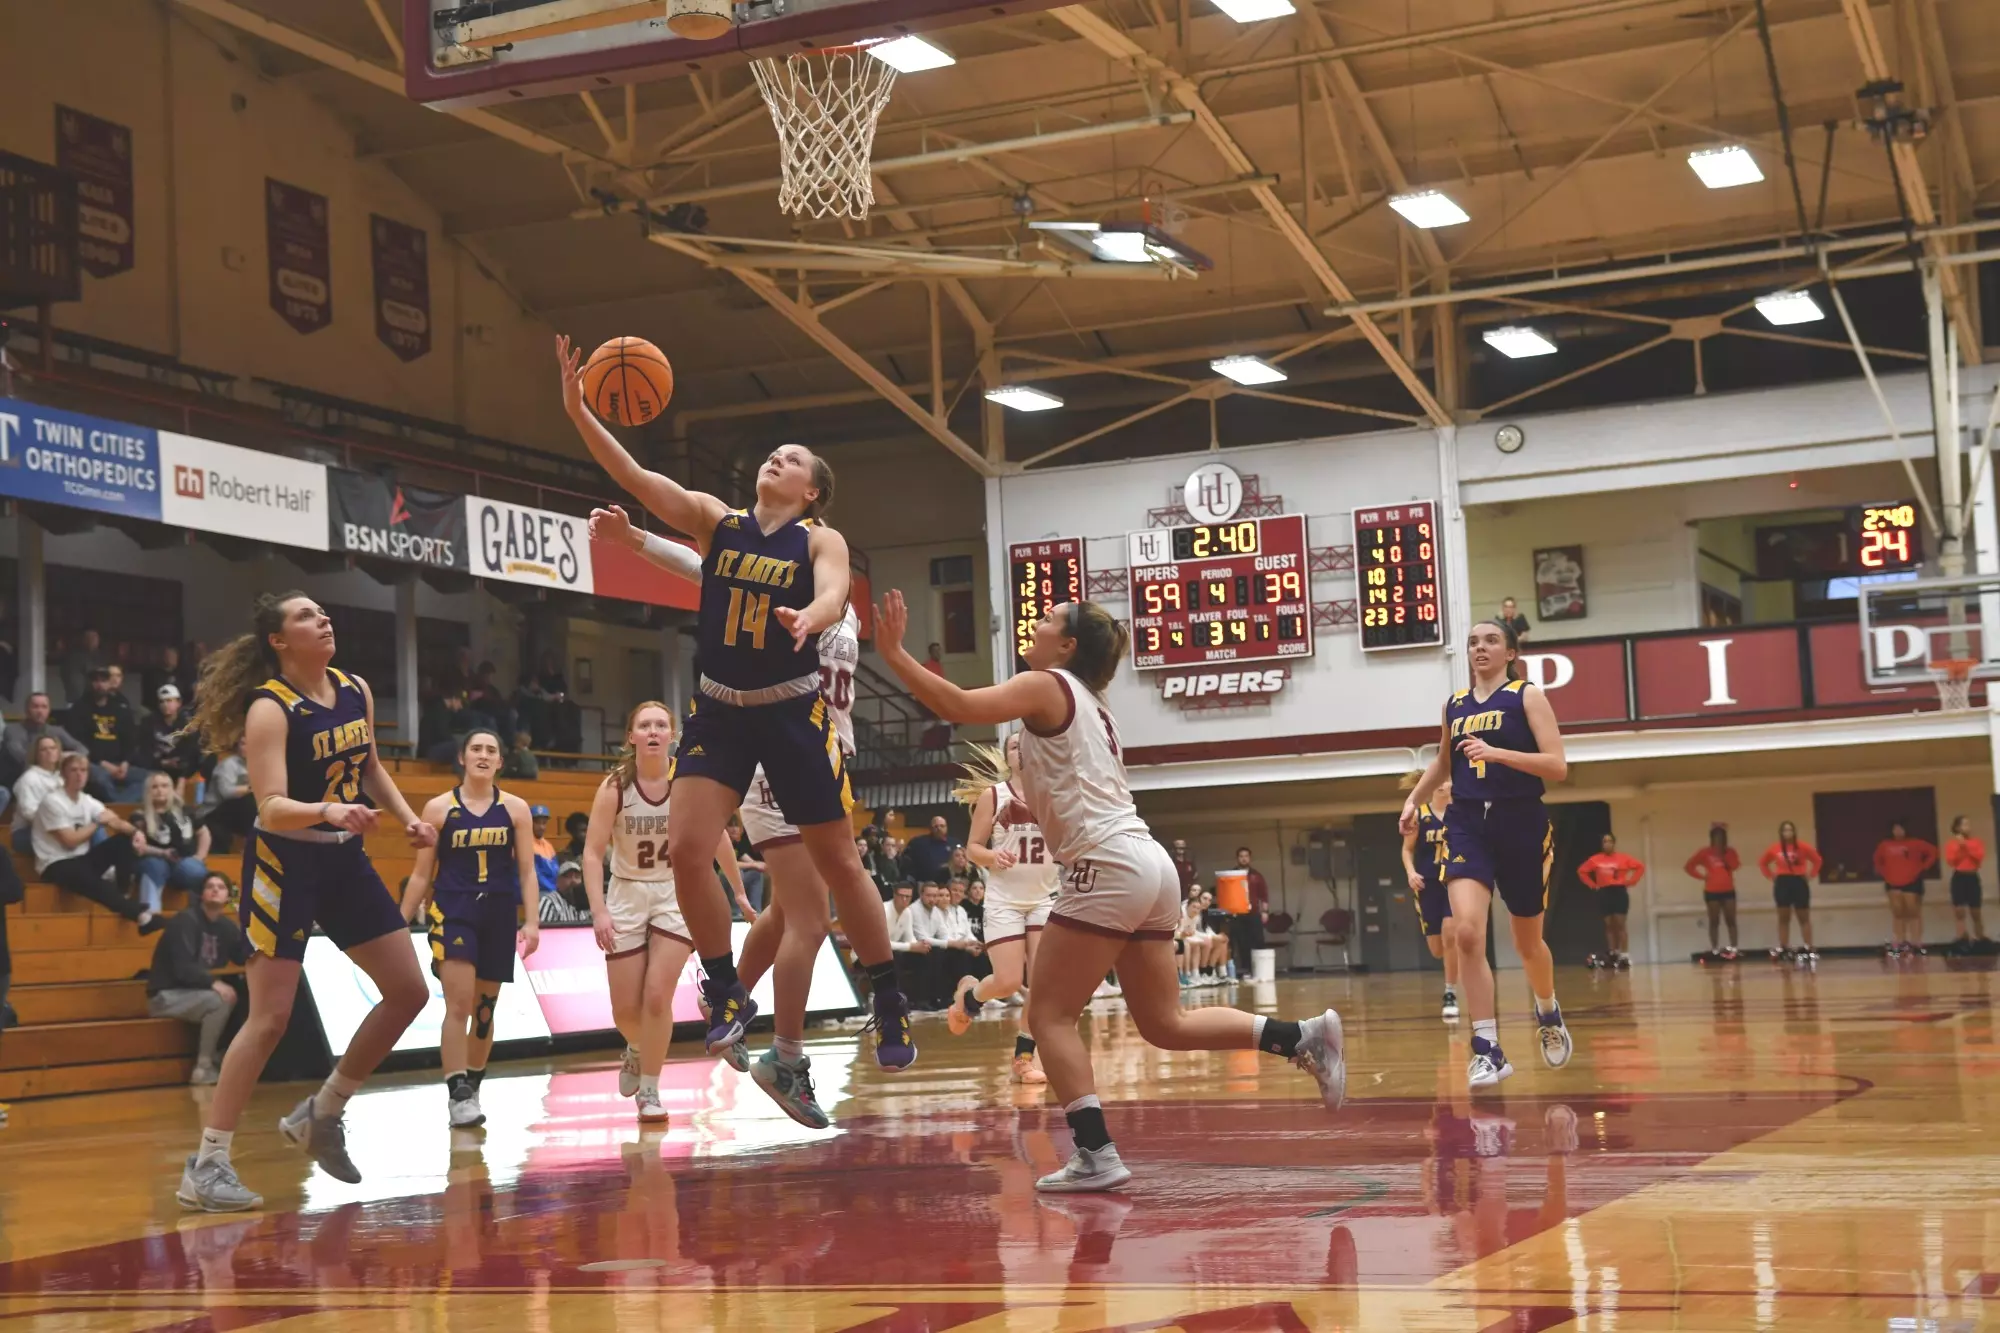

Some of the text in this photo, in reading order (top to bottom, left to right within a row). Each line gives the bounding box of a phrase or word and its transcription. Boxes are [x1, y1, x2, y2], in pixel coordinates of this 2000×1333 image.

[33, 418, 146, 461] TWIN CITIES
[26, 447, 156, 492] ORTHOPEDICS
[208, 470, 311, 513] Robert Half
[1196, 472, 1233, 516] HU
[1360, 507, 1424, 524] PLYR FLS PTS
[1863, 505, 1914, 531] 2:40
[343, 522, 455, 567] BSN SPORTS
[480, 505, 578, 585] GABE'S
[1377, 523, 1430, 544] 1 1 9
[1015, 543, 1073, 558] PLYR FLS PTS
[1138, 534, 1159, 562] HU
[1372, 542, 1431, 563] 4 0 0
[1861, 530, 1908, 567] 24
[1026, 558, 1078, 579] 3 4 5
[1135, 566, 1179, 582] PIPERS
[1201, 567, 1232, 580] PERIOD
[1254, 554, 1297, 571] GUEST
[1367, 564, 1433, 585] 10 1 1
[1020, 577, 1079, 597] 12 0 2
[1145, 572, 1301, 614] 59 4 39
[1369, 584, 1434, 604] 14 2 14
[724, 586, 771, 650] 14
[1021, 600, 1037, 617] 15
[1043, 600, 1053, 615] 2
[1135, 604, 1304, 628] FOULS PLAYER FOUL FOULS
[1364, 603, 1435, 627] 23 2 10
[1147, 616, 1302, 651] 3 4 3 4 1 1
[1136, 642, 1306, 666] SCORE MATCH SCORE
[1163, 669, 1285, 698] PIPERS
[1698, 639, 1737, 706] I
[321, 752, 368, 803] 23
[625, 815, 669, 836] PIPE
[1018, 836, 1045, 864] 12
[476, 850, 488, 883] 1
